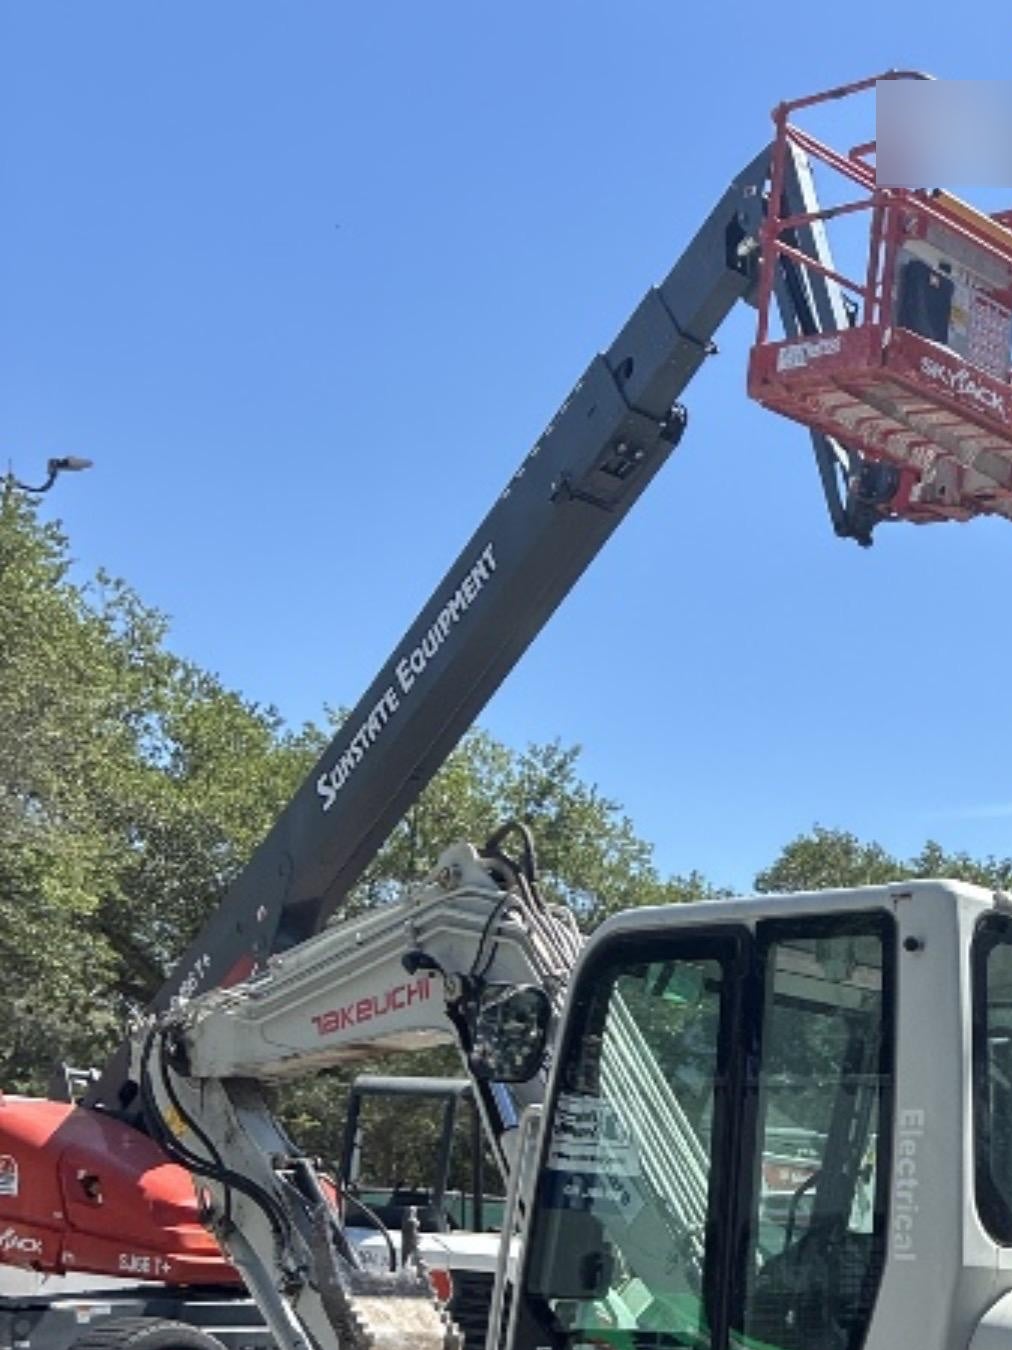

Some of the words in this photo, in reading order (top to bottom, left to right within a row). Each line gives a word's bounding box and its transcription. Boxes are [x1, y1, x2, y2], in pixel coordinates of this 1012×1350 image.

[316, 686, 400, 812] SUNSTATE
[394, 542, 497, 694] EQUIPMENT
[893, 1109, 925, 1261] Electrical
